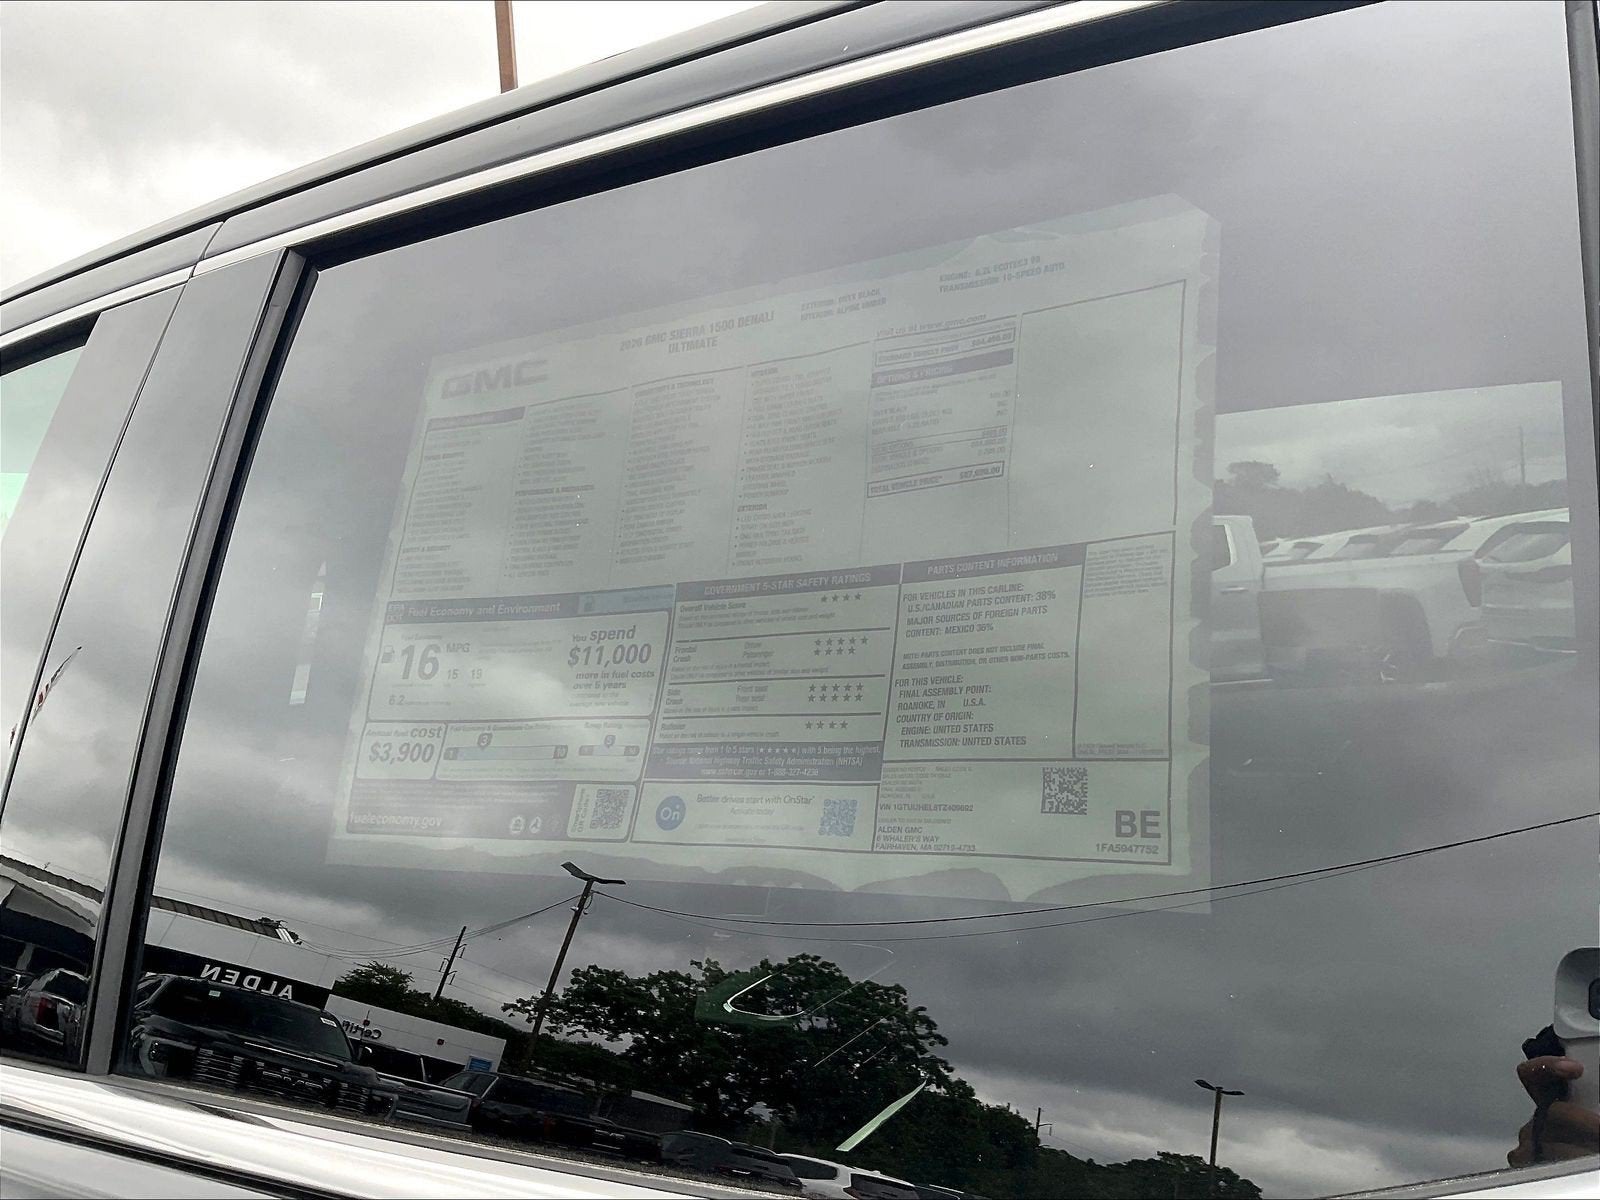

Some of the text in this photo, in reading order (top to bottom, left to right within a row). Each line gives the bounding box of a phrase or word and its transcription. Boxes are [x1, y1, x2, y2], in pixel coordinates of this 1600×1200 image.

[1002, 266, 1042, 282] 10-SPEED
[1043, 261, 1066, 273] AUTO
[645, 332, 668, 346] GMC
[669, 324, 706, 342] SIERRA
[709, 318, 735, 334] 1500
[737, 310, 776, 329] DENALI
[668, 335, 720, 353] ULTIMATE
[440, 358, 549, 400] GMC
[927, 552, 1059, 576] PARTS CONTENT INFORMATION
[703, 572, 872, 596] GOVERNMENT 5-STAR SAFETY RATINGS
[903, 582, 1025, 603] FOR VEHICLES IN THIS CARLINE:
[907, 589, 1057, 614] U.S./CANADIAN PARTS CONTENT: 38%
[408, 602, 562, 619] Fuel Economy and Environment
[906, 604, 1049, 627] MAJOR SOURCES OF FOREIGN PARTS
[572, 624, 637, 645] You spend
[905, 628, 943, 640] CONTENT:
[944, 624, 976, 635] MEXICO
[567, 642, 653, 670] $11,000
[920, 650, 940, 659] PARTS
[940, 648, 967, 658] CONTENT
[968, 646, 985, 656] DOES
[986, 645, 998, 655] NOT
[978, 656, 988, 665] OR
[989, 655, 1009, 665] OTHER
[1010, 652, 1046, 663] NON-PARTS
[400, 643, 442, 682] 16
[446, 642, 471, 654] MPG
[447, 668, 460, 680] 15
[576, 669, 656, 680] more in fuel costs
[894, 674, 964, 687] FOR THIS VEHICLE:
[572, 680, 627, 692] over 5 years
[899, 684, 992, 699] FINAL ASSEMBLY POINT:
[897, 698, 987, 712] ROANOKE, IN U.S.A.
[896, 711, 974, 723] COUNTRY OF ORIGIN:
[410, 725, 443, 739] cost
[901, 723, 994, 736] ENGINE: UNITED STATES
[900, 735, 1027, 749] TRANSMISSION: UNITED STATES
[368, 741, 435, 765] $3,900
[823, 744, 842, 756] being
[843, 745, 854, 754] the
[764, 756, 785, 768] Safety
[786, 757, 835, 767] Administration
[836, 757, 864, 768] (NHTSA)
[696, 793, 720, 804] Better
[721, 794, 744, 804] drives
[745, 795, 764, 804] start
[764, 795, 782, 804] with
[659, 804, 682, 821] On
[878, 803, 892, 811] VIN
[877, 826, 923, 835] ALDEN GMC
[1115, 810, 1162, 838] BE
[883, 834, 921, 844] WHALER'S
[922, 835, 941, 844] WAY
[875, 843, 918, 852] FAIRHAVEN,
[1095, 843, 1160, 855] 1FA5947752
